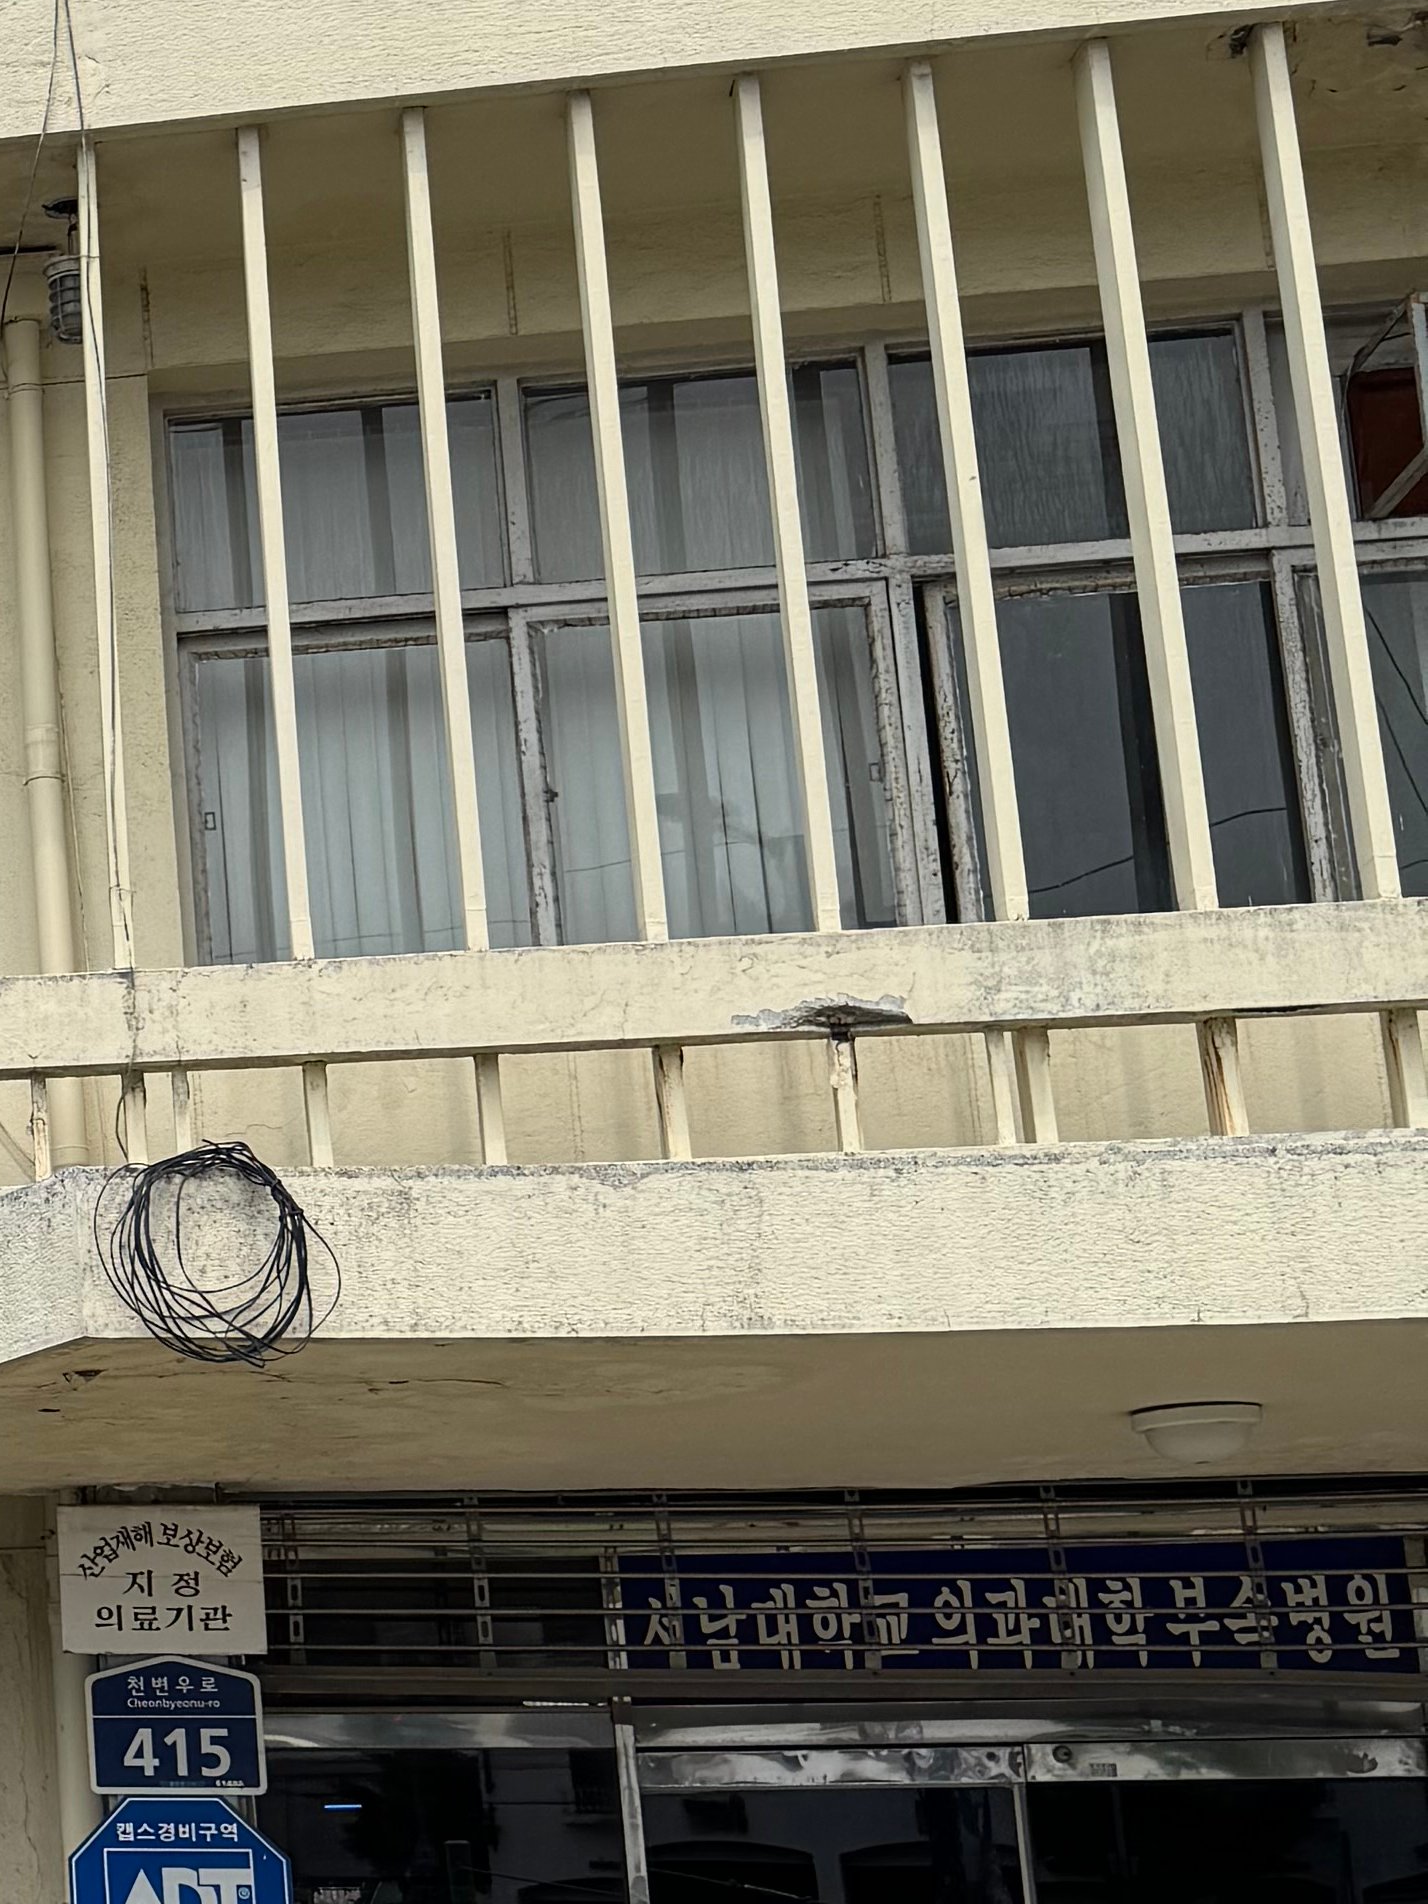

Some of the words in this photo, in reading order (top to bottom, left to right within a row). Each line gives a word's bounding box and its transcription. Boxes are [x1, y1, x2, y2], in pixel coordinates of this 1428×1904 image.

[94, 1604, 233, 1633] 의료기관
[127, 1675, 219, 1696] 천변우로
[123, 1727, 232, 1778] 415
[115, 1821, 239, 1843] 캡스경비구역
